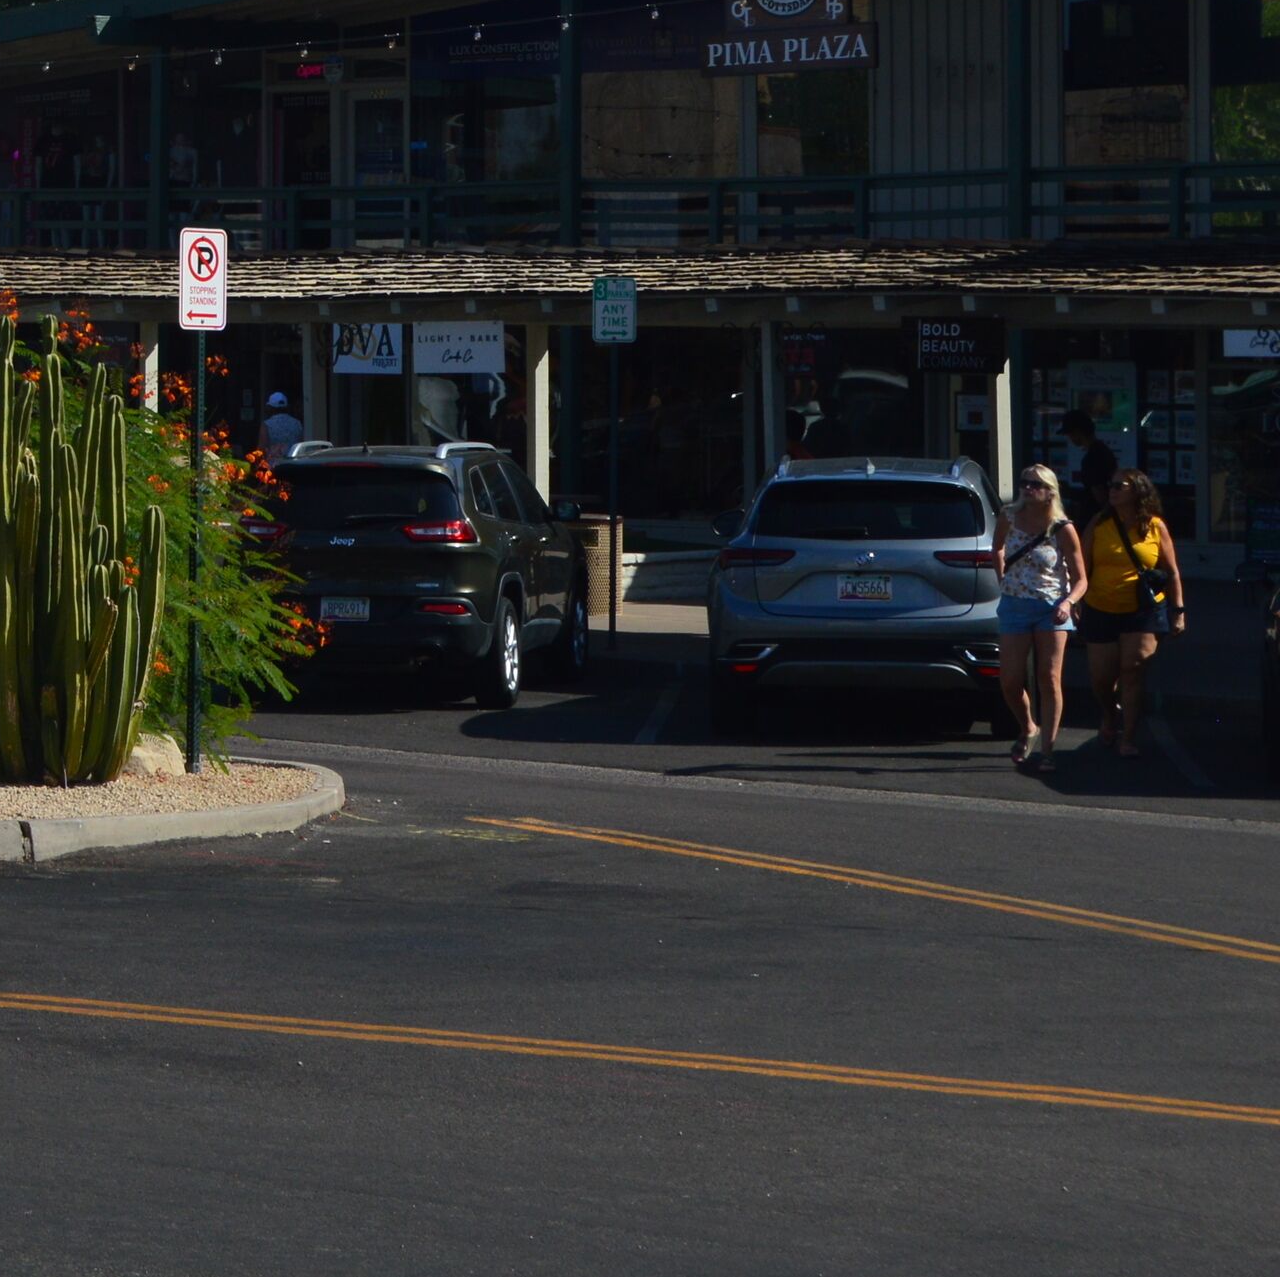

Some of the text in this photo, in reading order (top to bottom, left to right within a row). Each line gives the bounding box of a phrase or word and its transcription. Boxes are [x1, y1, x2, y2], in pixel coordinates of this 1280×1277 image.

[472, 40, 559, 54] CONSTRUCTION
[707, 40, 774, 68] PIMA
[783, 34, 869, 62] PLAZA
[190, 286, 217, 295] STOPPING
[596, 283, 606, 298] 3
[190, 297, 217, 305] STANDING
[602, 304, 626, 314] ANY
[601, 316, 628, 327] TIME
[922, 324, 961, 336] BOLD
[340, 324, 394, 356] DVA
[418, 335, 451, 343] LIGHT
[470, 334, 498, 343] BARK
[922, 340, 975, 353] BEAUTY
[922, 355, 987, 369] COMPANY
[329, 536, 355, 546] Jeep
